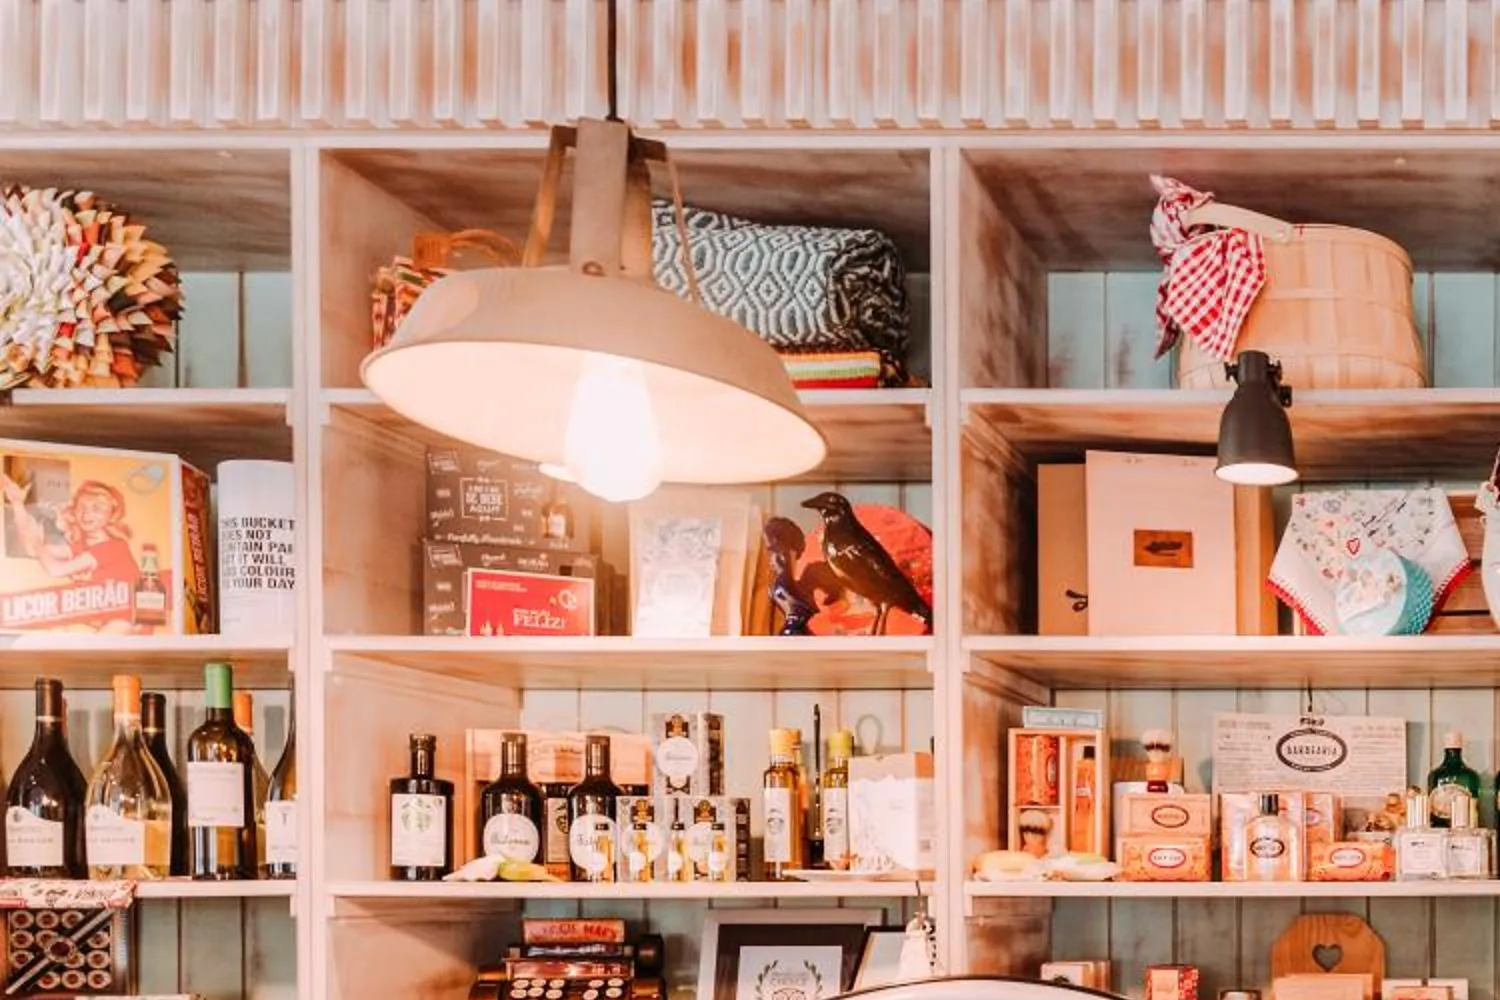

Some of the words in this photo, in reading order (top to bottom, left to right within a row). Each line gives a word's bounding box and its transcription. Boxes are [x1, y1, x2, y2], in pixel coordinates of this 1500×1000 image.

[241, 517, 295, 530] BUCKET
[246, 529, 271, 541] NOT
[252, 553, 287, 566] WILL
[240, 565, 295, 578] COLOUR
[267, 577, 295, 589] DAY
[5, 592, 58, 622] LICOR
[61, 579, 129, 613] BEIRÃO
